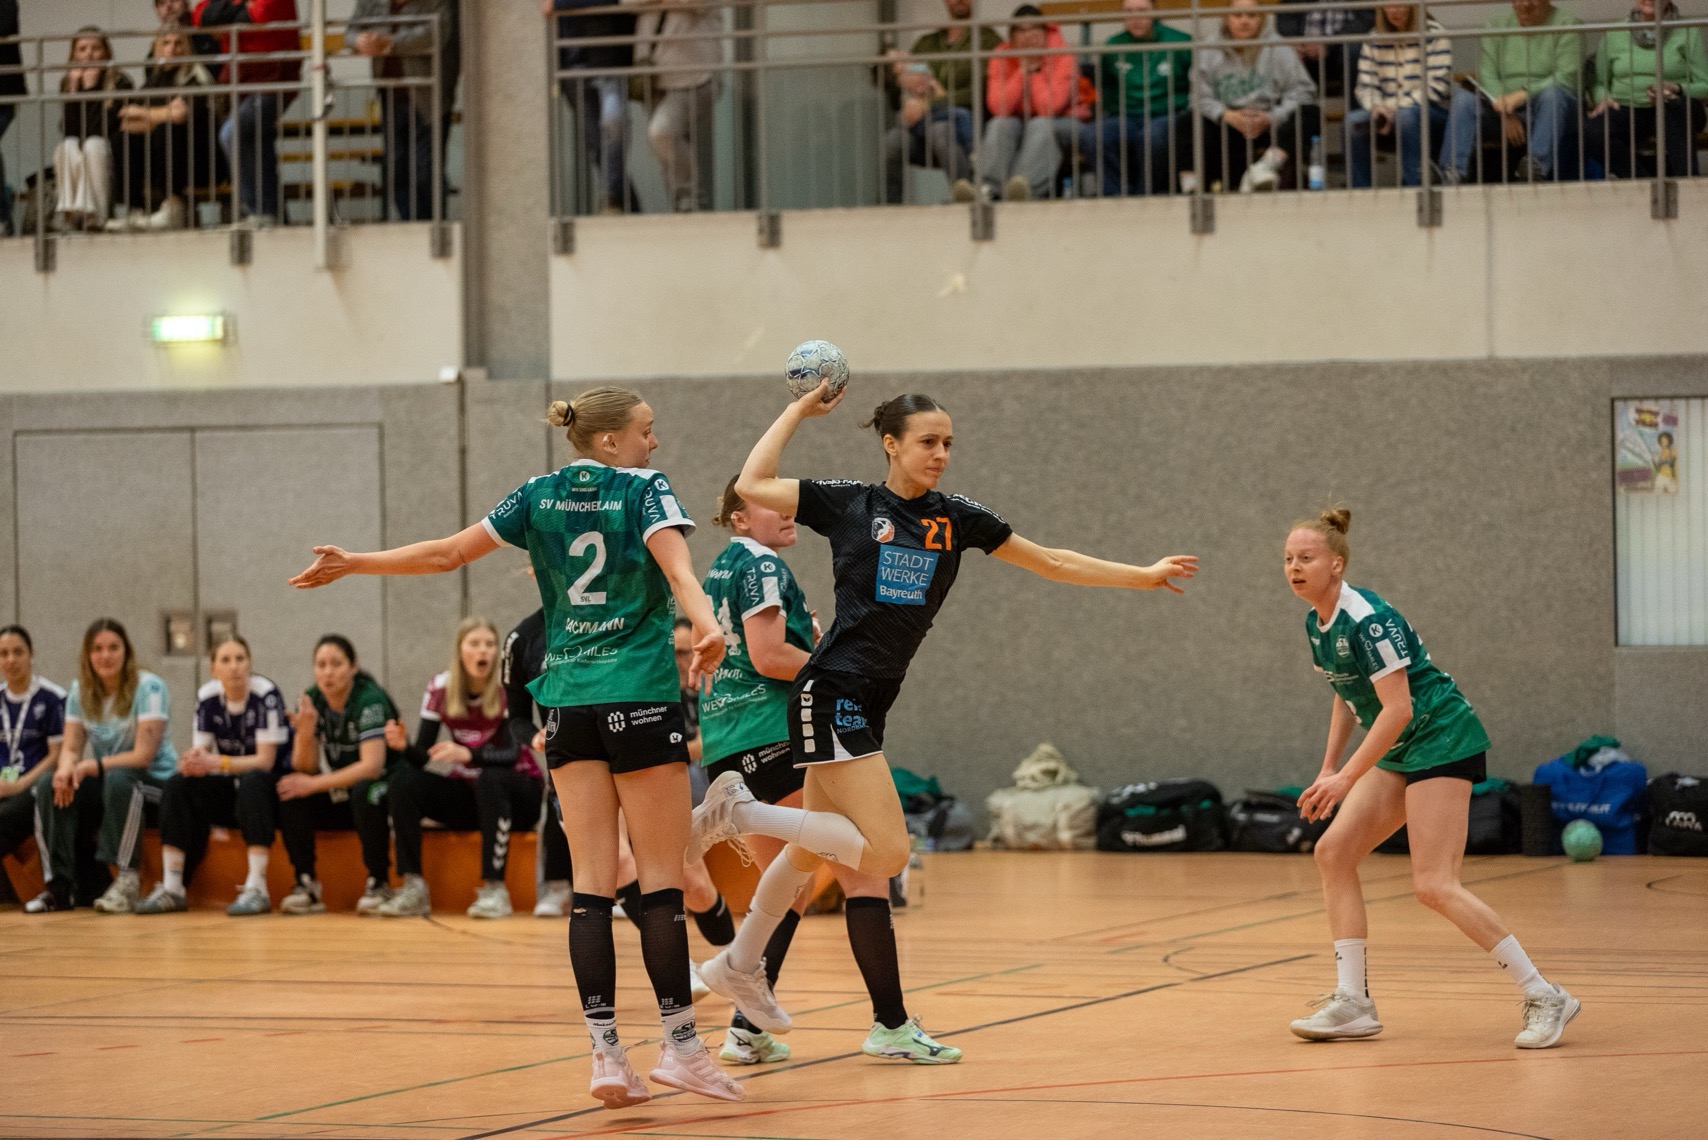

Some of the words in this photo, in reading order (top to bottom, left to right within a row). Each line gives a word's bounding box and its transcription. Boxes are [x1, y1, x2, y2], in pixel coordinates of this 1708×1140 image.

[539, 499, 554, 509] SV
[921, 517, 952, 551] 27
[567, 531, 607, 605] 2
[883, 551, 934, 570] STADT
[881, 567, 929, 586] WERKE
[880, 585, 922, 599] Bayreuth
[630, 705, 667, 718] münchner
[631, 714, 662, 726] wohnen
